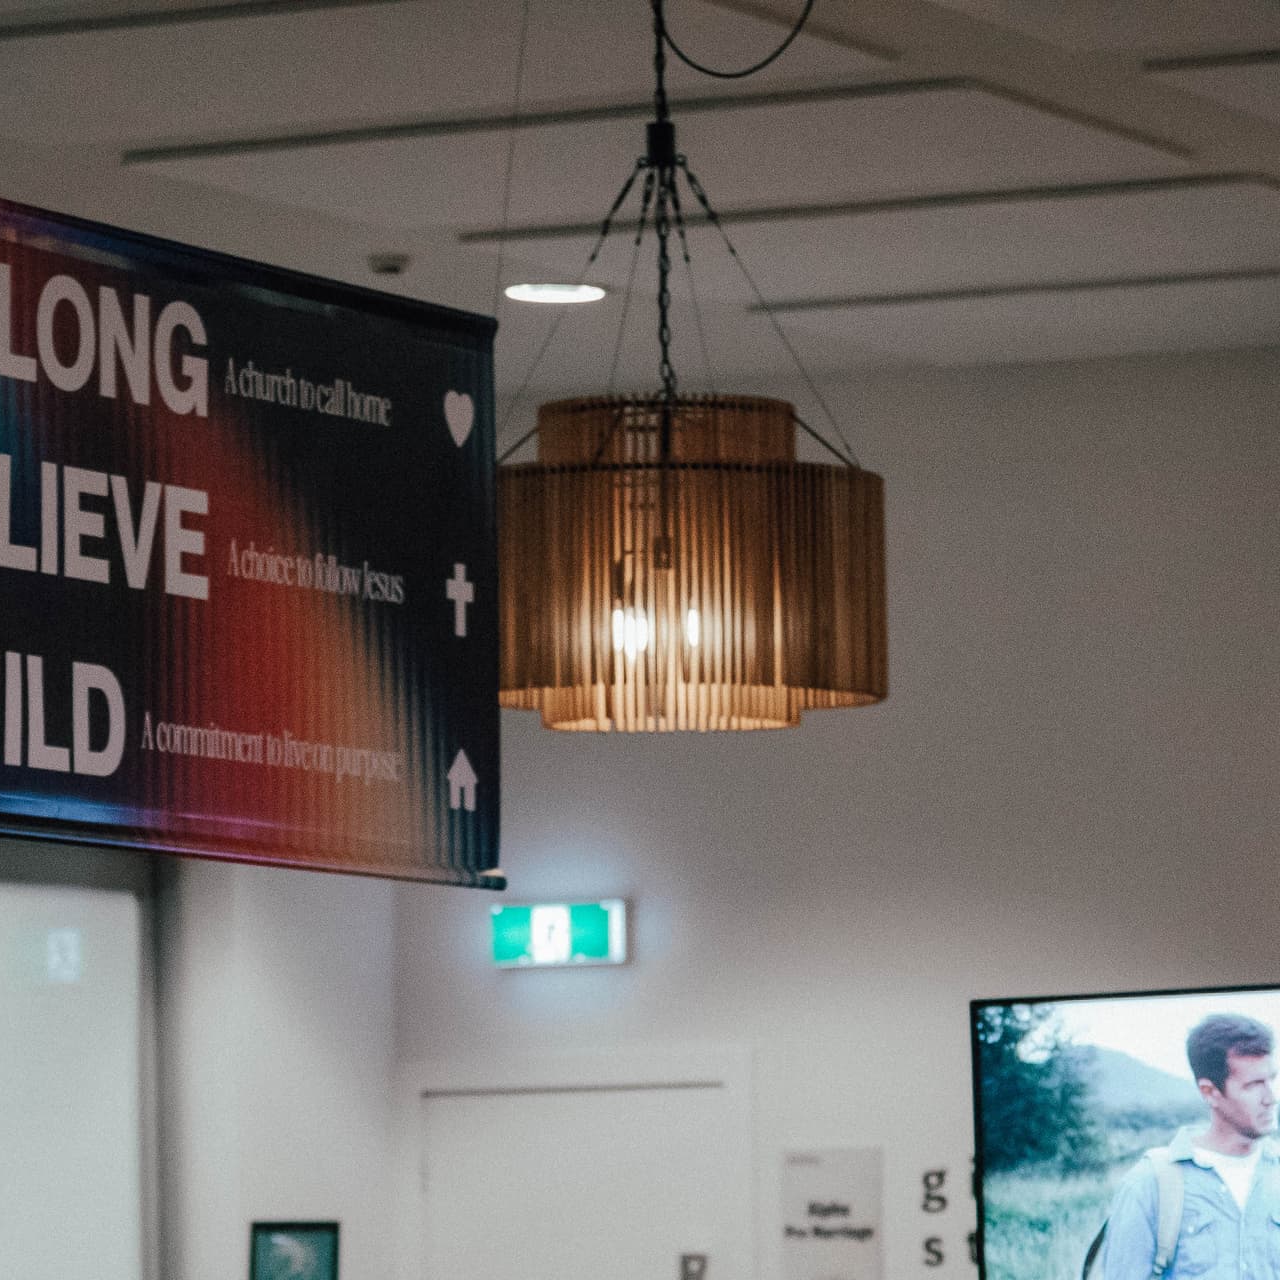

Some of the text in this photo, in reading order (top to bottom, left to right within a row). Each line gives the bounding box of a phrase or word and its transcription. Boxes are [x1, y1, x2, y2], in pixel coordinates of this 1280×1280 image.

[223, 357, 237, 395] A
[238, 359, 297, 407] church
[298, 378, 315, 410] to
[346, 380, 393, 427] home
[226, 539, 239, 577] A
[240, 541, 294, 586] choice
[314, 553, 361, 595] follow
[361, 560, 406, 604] Jesus
[141, 711, 154, 750] A
[156, 720, 264, 764] commitment
